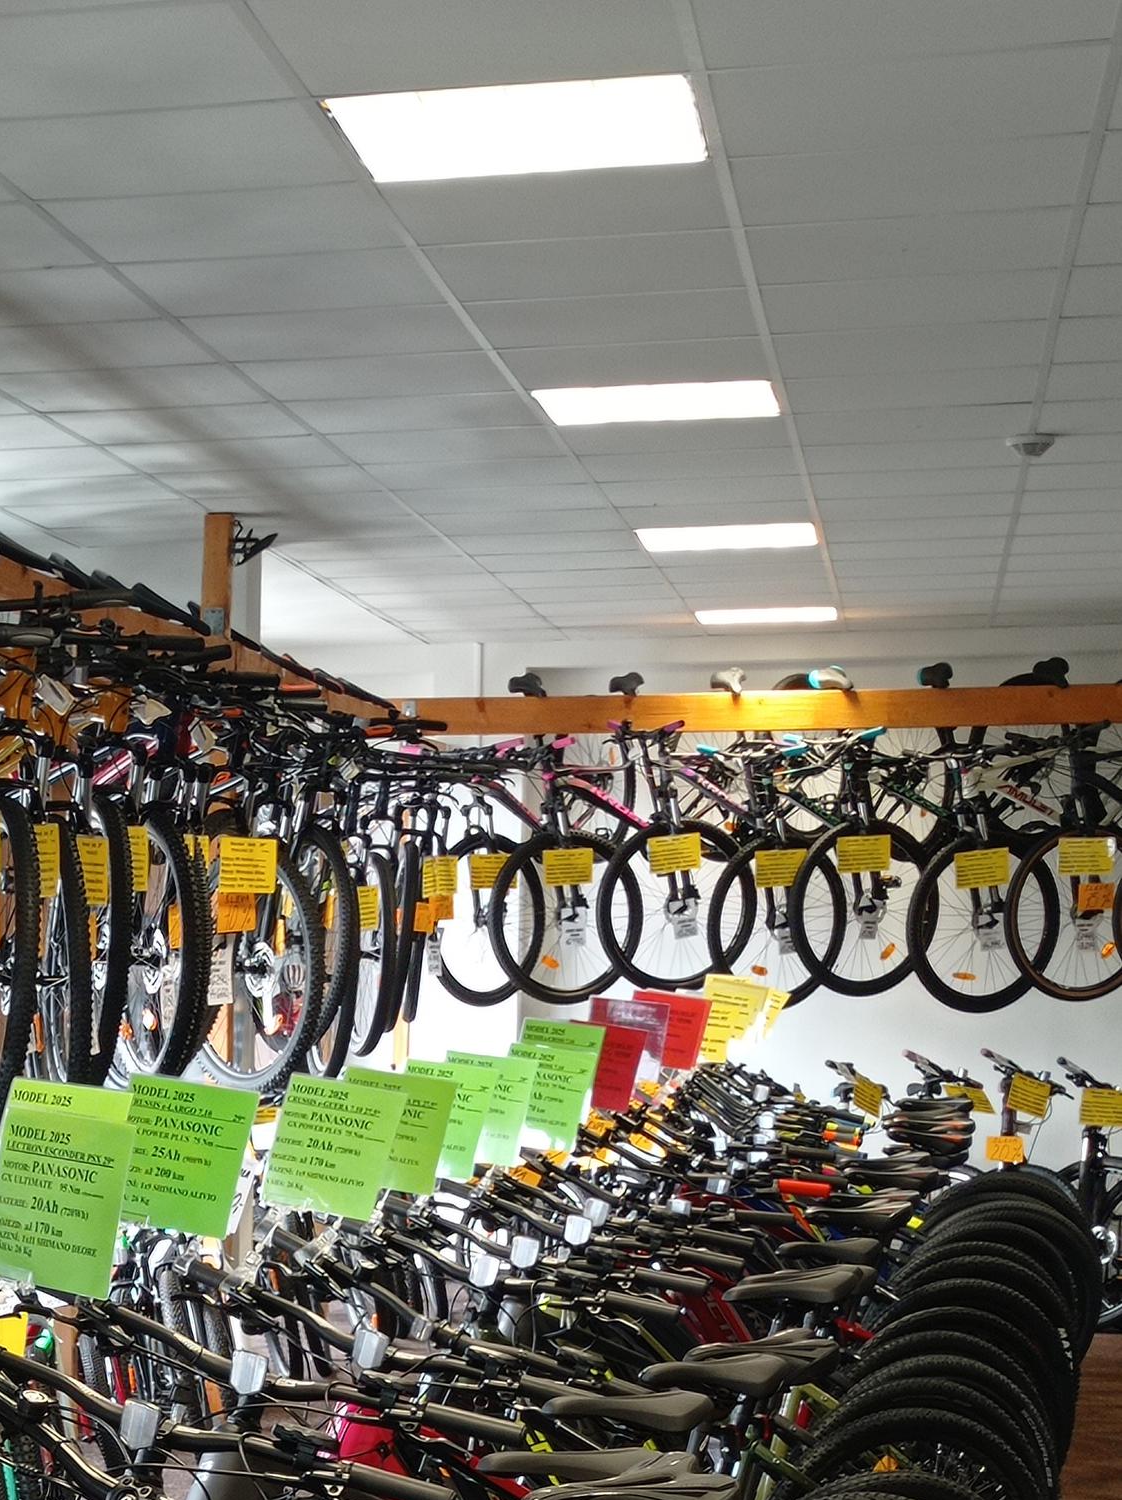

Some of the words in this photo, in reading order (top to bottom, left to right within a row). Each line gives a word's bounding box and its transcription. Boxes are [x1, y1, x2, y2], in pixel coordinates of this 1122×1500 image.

[13, 1090, 48, 1106] MODEL
[51, 1095, 72, 1107] 2025
[133, 1084, 170, 1099] MODEL
[172, 1090, 196, 1103] 2025
[292, 1084, 326, 1097] MODEL
[154, 1116, 223, 1137] PANASONIC
[310, 1112, 373, 1131] PANASONIC
[10, 1124, 47, 1141] MODEL
[50, 1131, 71, 1145] 2025
[151, 1146, 180, 1161] 25Ah
[306, 1138, 333, 1152] 20Ah
[309, 1155, 324, 1167] 170
[31, 1161, 99, 1184] PANASONIC
[1, 1173, 15, 1184] GX
[17, 1175, 52, 1190] ULTIMATE
[30, 1196, 58, 1215] 20Ah
[34, 1221, 50, 1234] 170
[51, 1227, 63, 1238] km
[37, 1237, 70, 1252] SHIMANO
